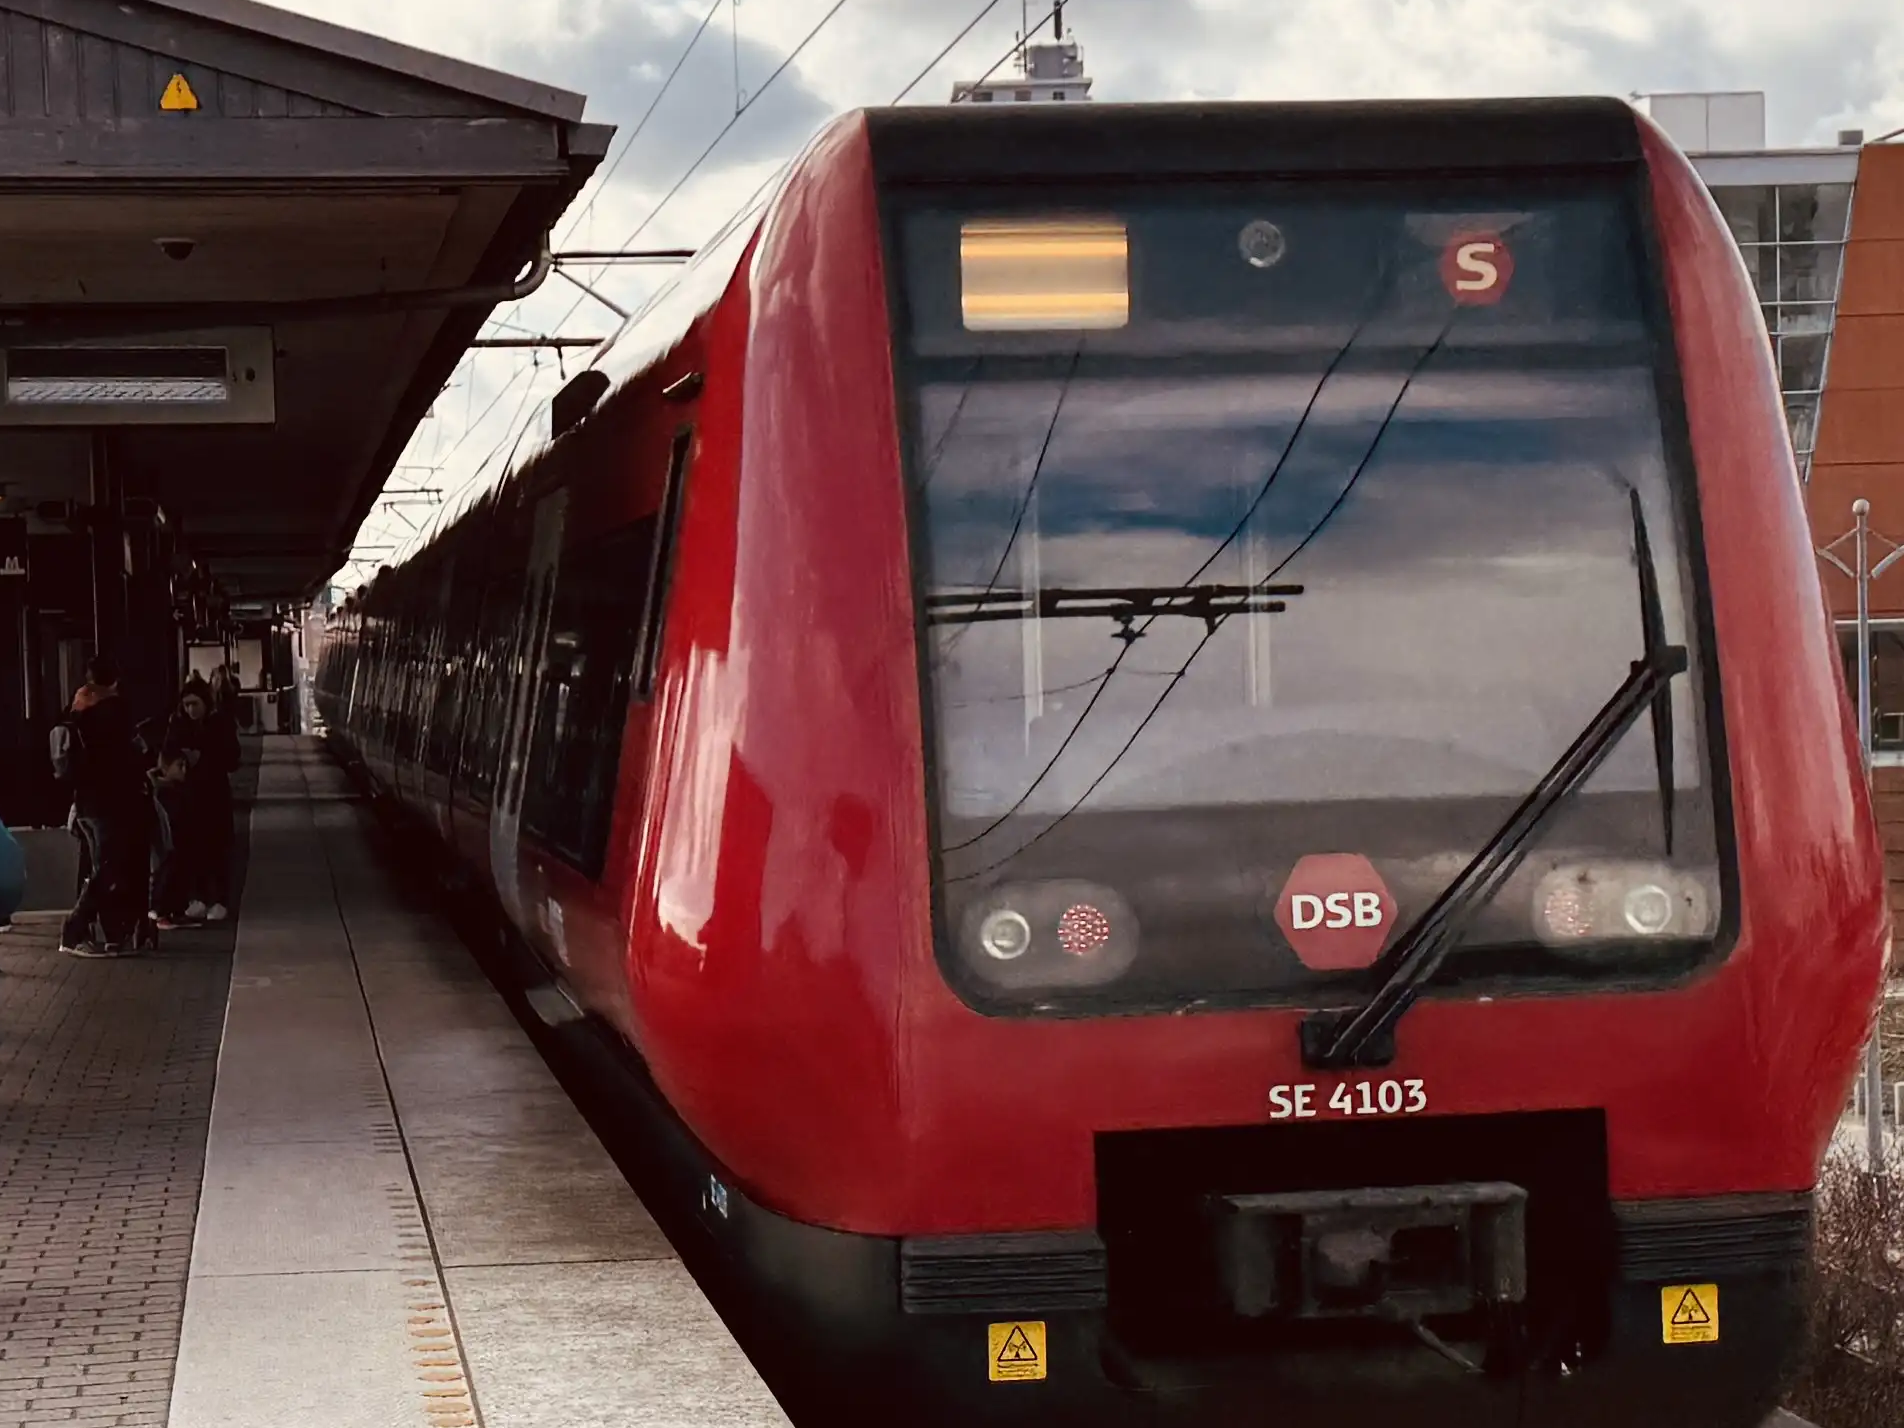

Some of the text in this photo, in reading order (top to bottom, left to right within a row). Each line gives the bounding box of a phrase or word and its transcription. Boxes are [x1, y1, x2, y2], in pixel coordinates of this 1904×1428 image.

[1457, 242, 1498, 290] S
[1291, 892, 1383, 930] DSB
[1268, 1079, 1427, 1118] SE 4103
